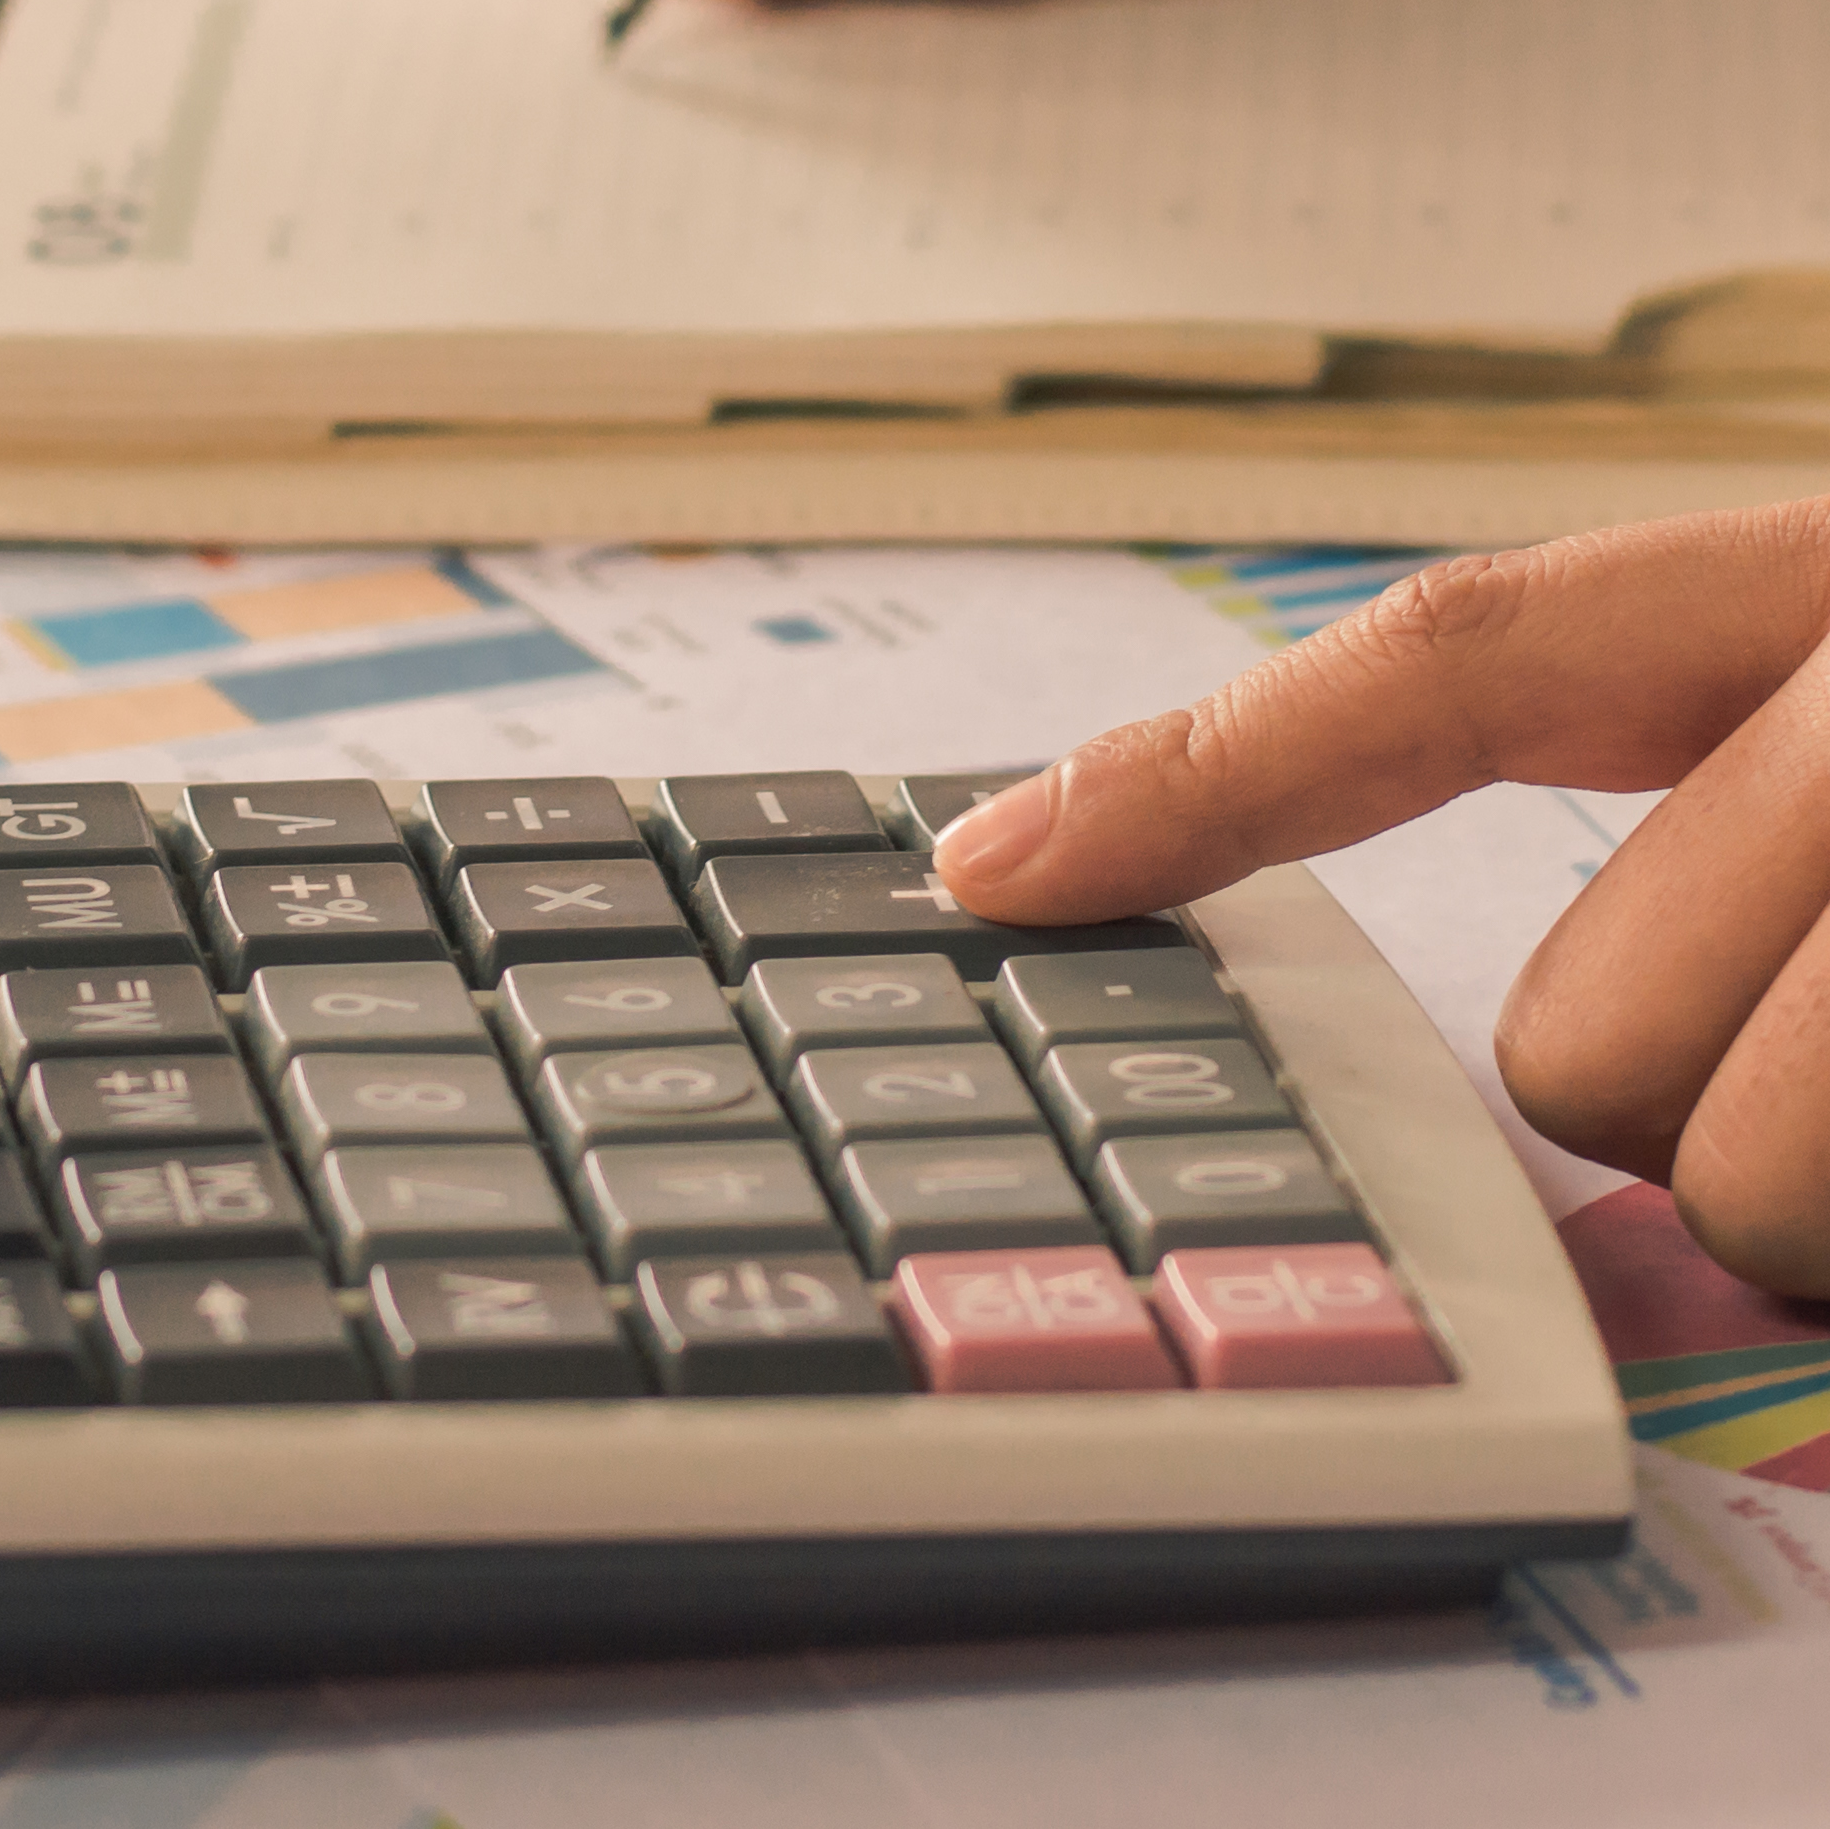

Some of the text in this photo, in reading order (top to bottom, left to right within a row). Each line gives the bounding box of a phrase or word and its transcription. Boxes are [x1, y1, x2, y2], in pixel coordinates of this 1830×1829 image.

[21, 876, 124, 930] MU
[310, 991, 420, 1018] 9
[562, 986, 673, 1013] 6
[814, 981, 923, 1010] 3
[603, 1068, 717, 1100] 5
[862, 1072, 977, 1102] 2
[1107, 1052, 1236, 1107] 00
[353, 1081, 468, 1113] 8
[387, 1175, 509, 1209] 7
[655, 1174, 767, 1205] 4
[917, 1172, 1024, 1196] 1
[1175, 1160, 1289, 1195] 0
